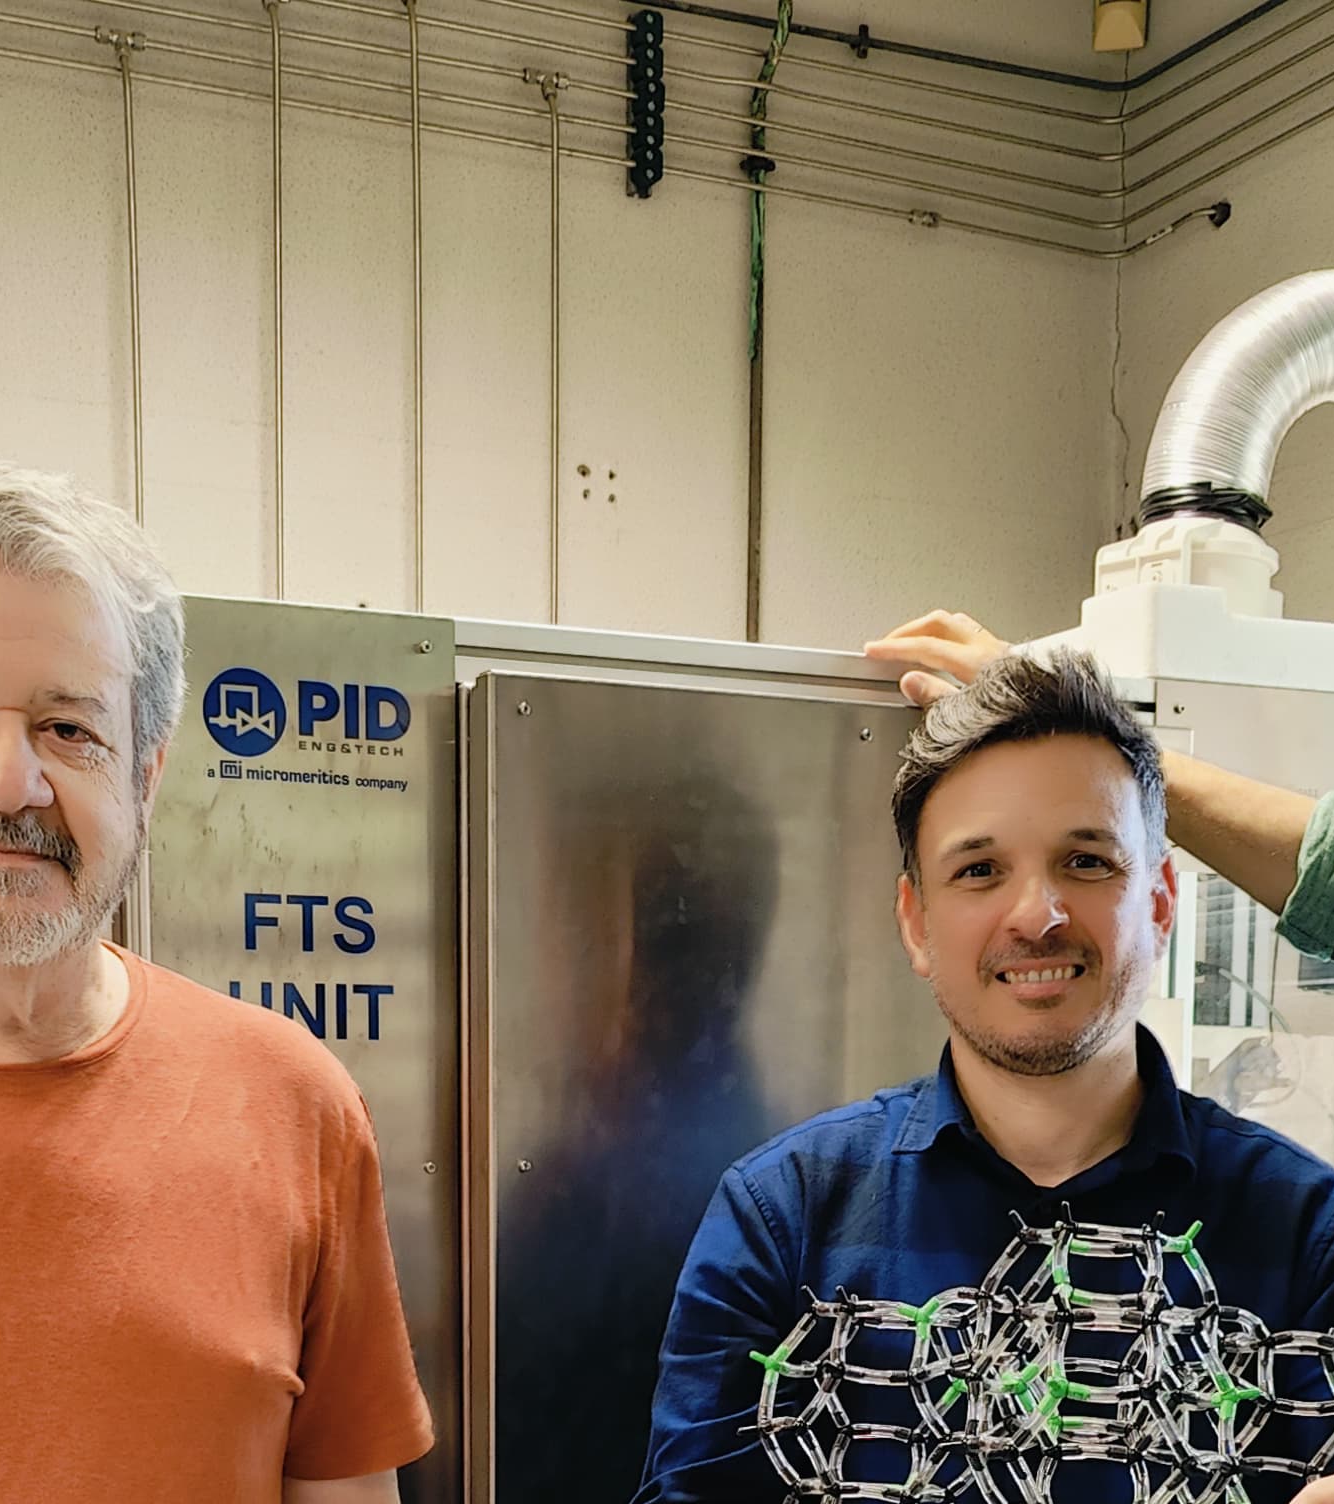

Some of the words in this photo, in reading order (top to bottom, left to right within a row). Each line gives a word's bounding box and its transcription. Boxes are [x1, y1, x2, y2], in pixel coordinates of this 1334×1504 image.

[298, 680, 411, 742] PID
[298, 740, 404, 757] ENG&TECH
[207, 768, 215, 778] a
[246, 766, 350, 786] micromeritics
[355, 777, 408, 792] company
[244, 893, 375, 954] FTS
